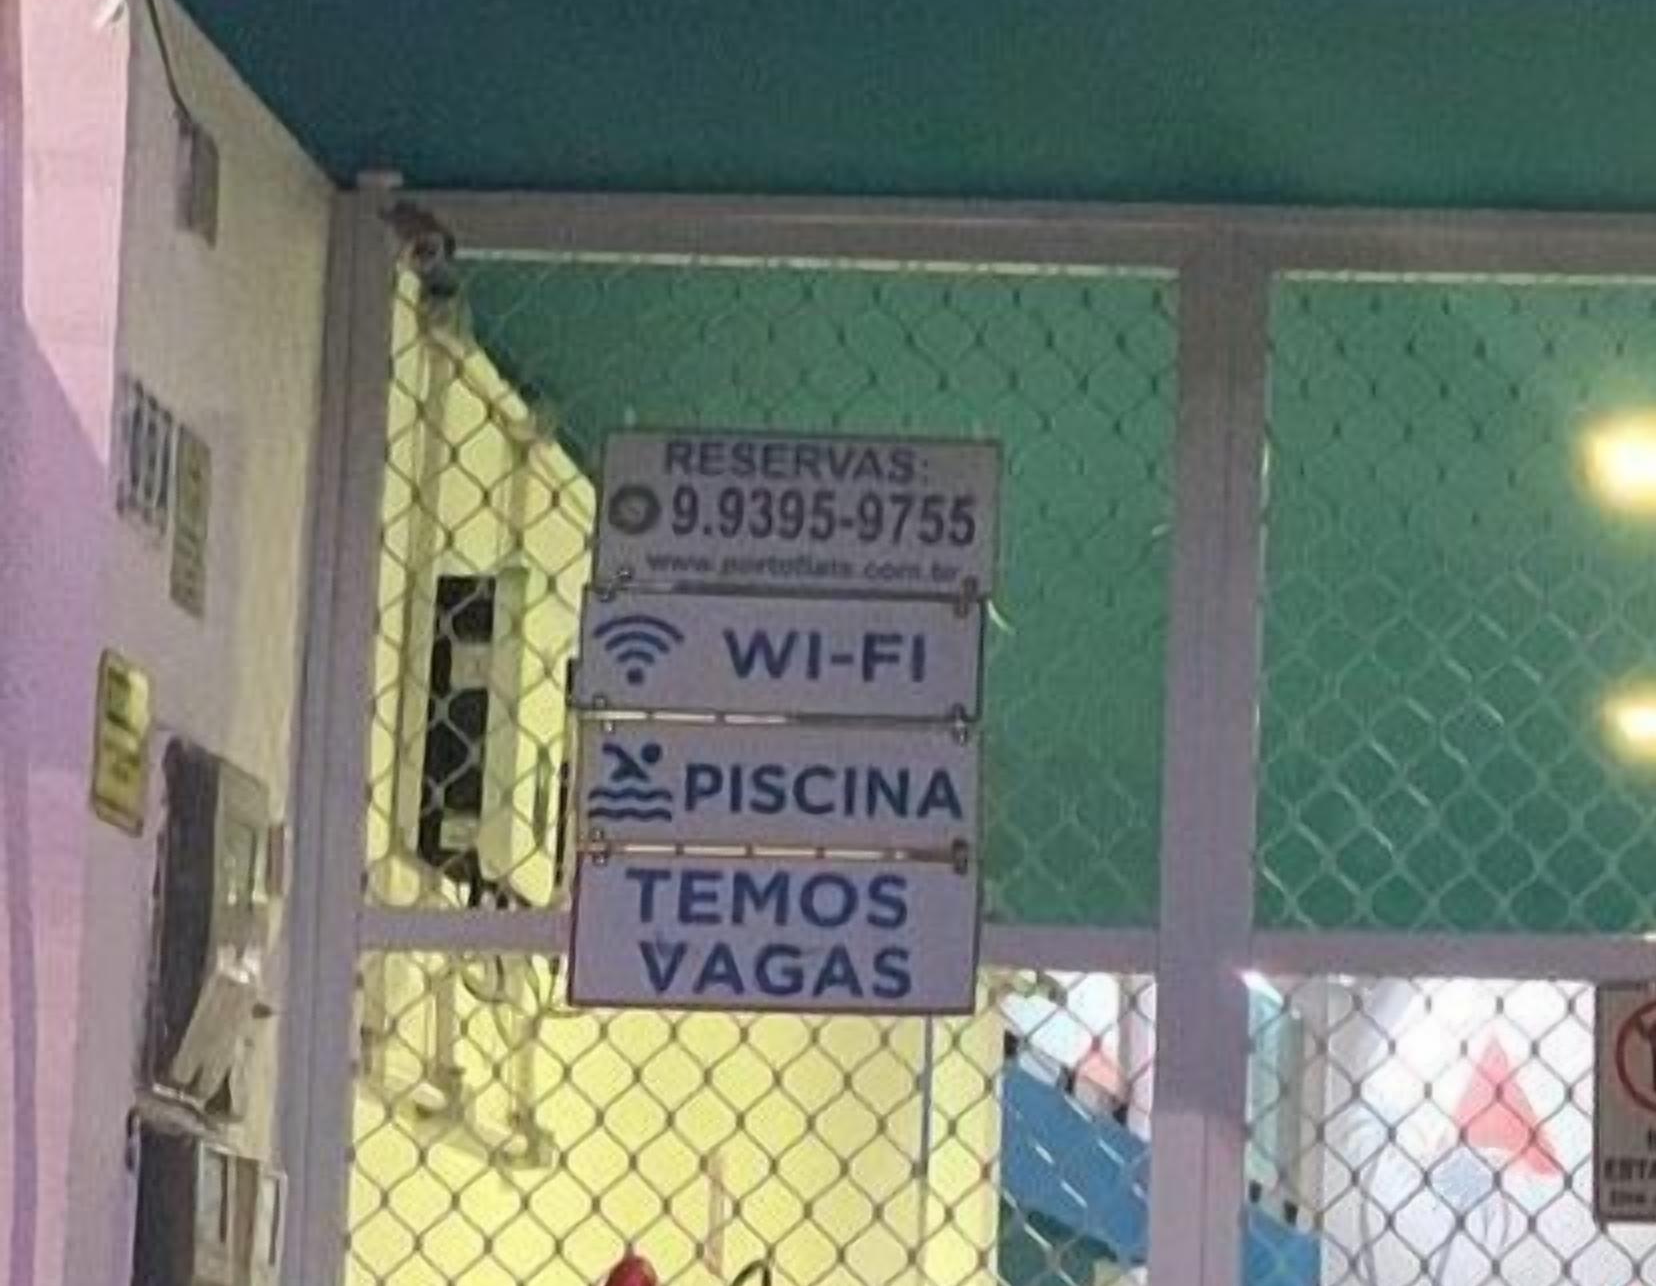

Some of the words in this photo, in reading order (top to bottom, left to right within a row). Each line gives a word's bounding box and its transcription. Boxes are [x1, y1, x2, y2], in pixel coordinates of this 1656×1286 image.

[672, 485, 978, 547] 9.9395-9755
[723, 629, 928, 683] WI-FI
[683, 763, 964, 819] PISCINA
[625, 868, 909, 929] TEMOS
[639, 940, 913, 1000] VAGAS
